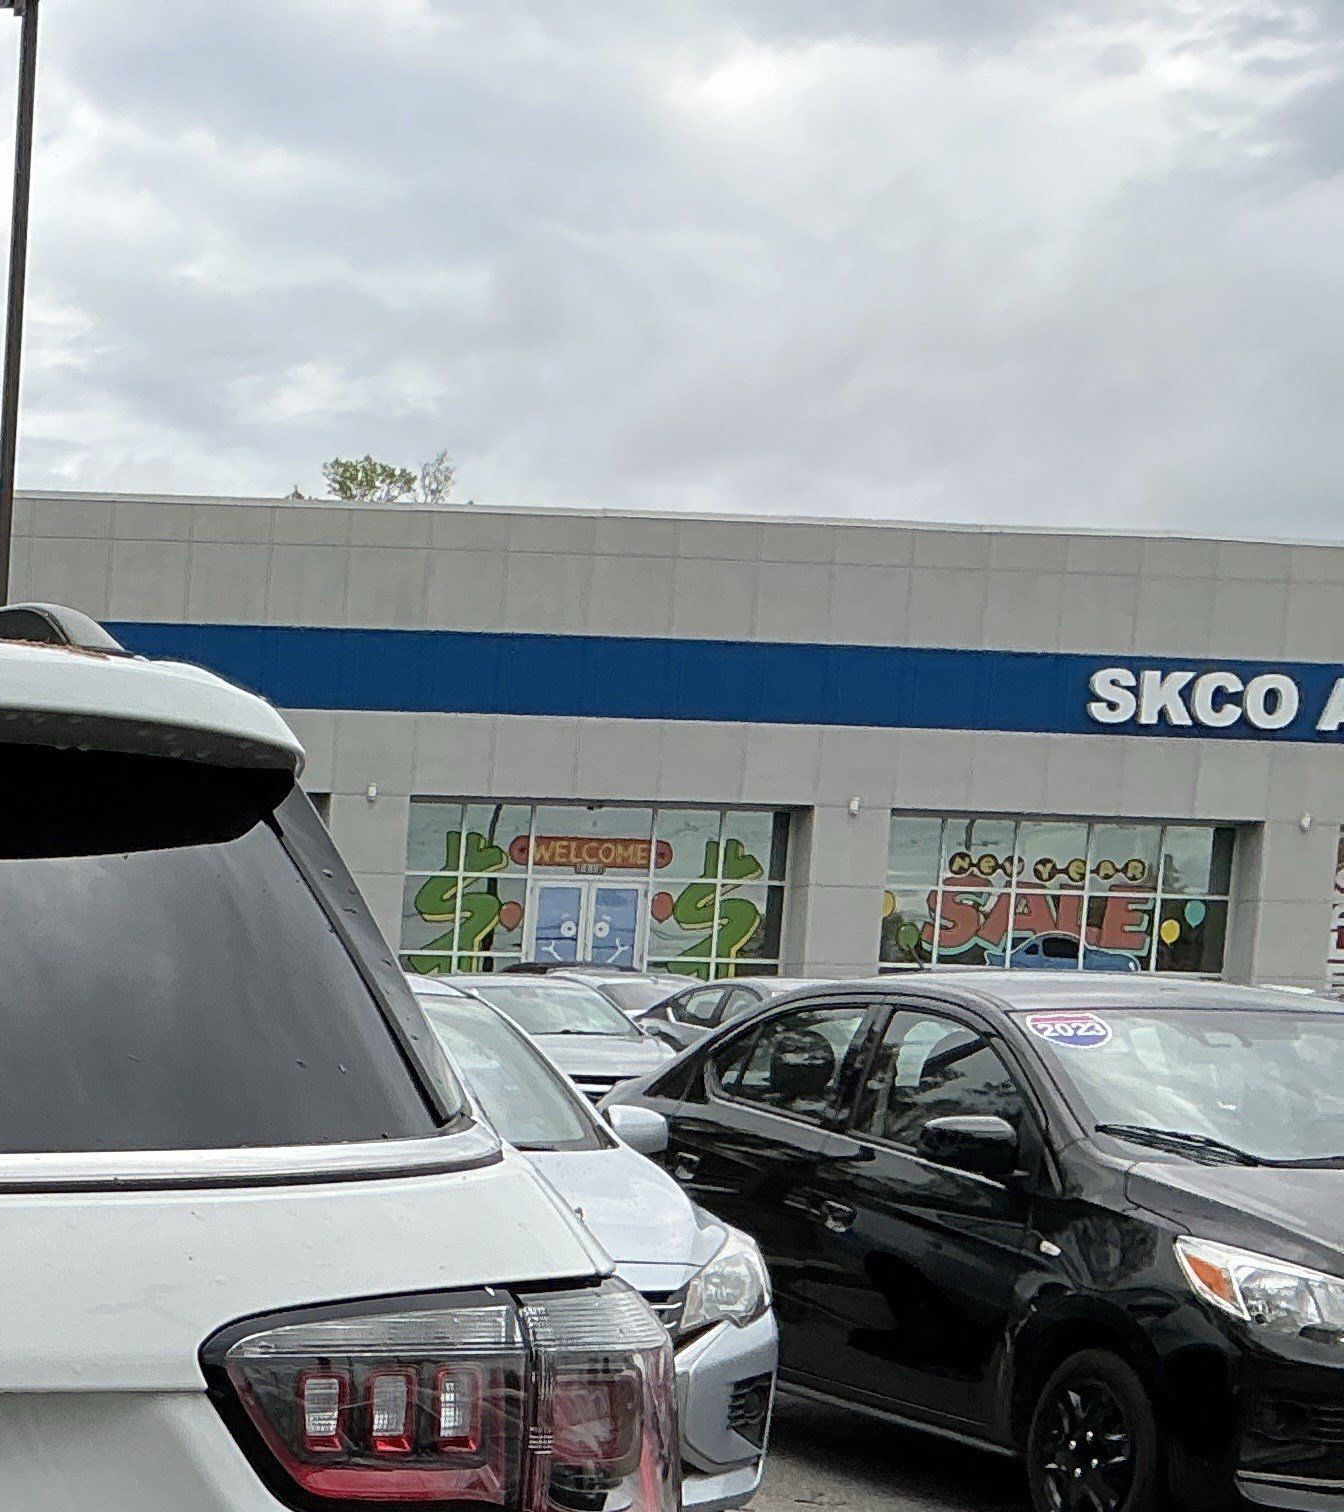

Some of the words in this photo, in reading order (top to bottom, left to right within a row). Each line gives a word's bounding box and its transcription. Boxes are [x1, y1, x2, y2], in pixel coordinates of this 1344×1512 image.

[1086, 668, 1299, 730] SKCO
[534, 841, 649, 864] WELCOME
[950, 851, 1024, 877] NEW
[1034, 857, 1147, 882] YEAR
[921, 874, 1155, 955] SALE
